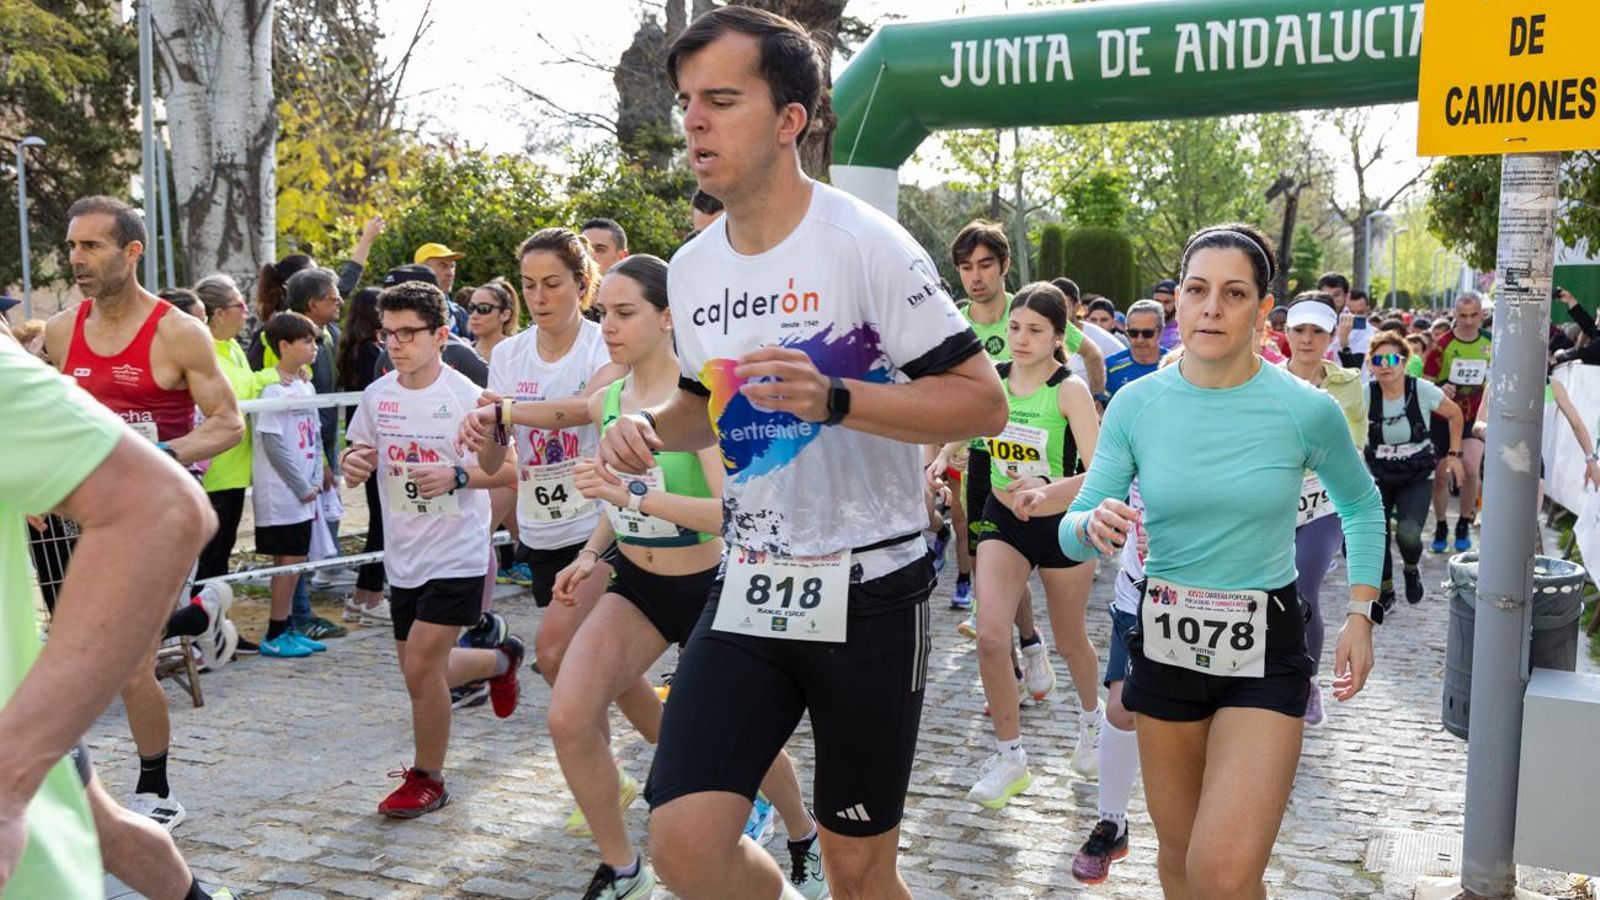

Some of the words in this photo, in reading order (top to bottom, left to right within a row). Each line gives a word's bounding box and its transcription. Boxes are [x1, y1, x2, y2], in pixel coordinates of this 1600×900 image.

[1509, 14, 1546, 56] DE
[940, 33, 1074, 88] JUNTA
[1096, 26, 1151, 78] DE
[1445, 77, 1597, 126] CAMIONES
[1457, 368, 1480, 378] 822
[987, 438, 1041, 461] 1089
[534, 484, 569, 506] 64
[745, 573, 823, 610] 818
[1154, 612, 1255, 651] 1078
